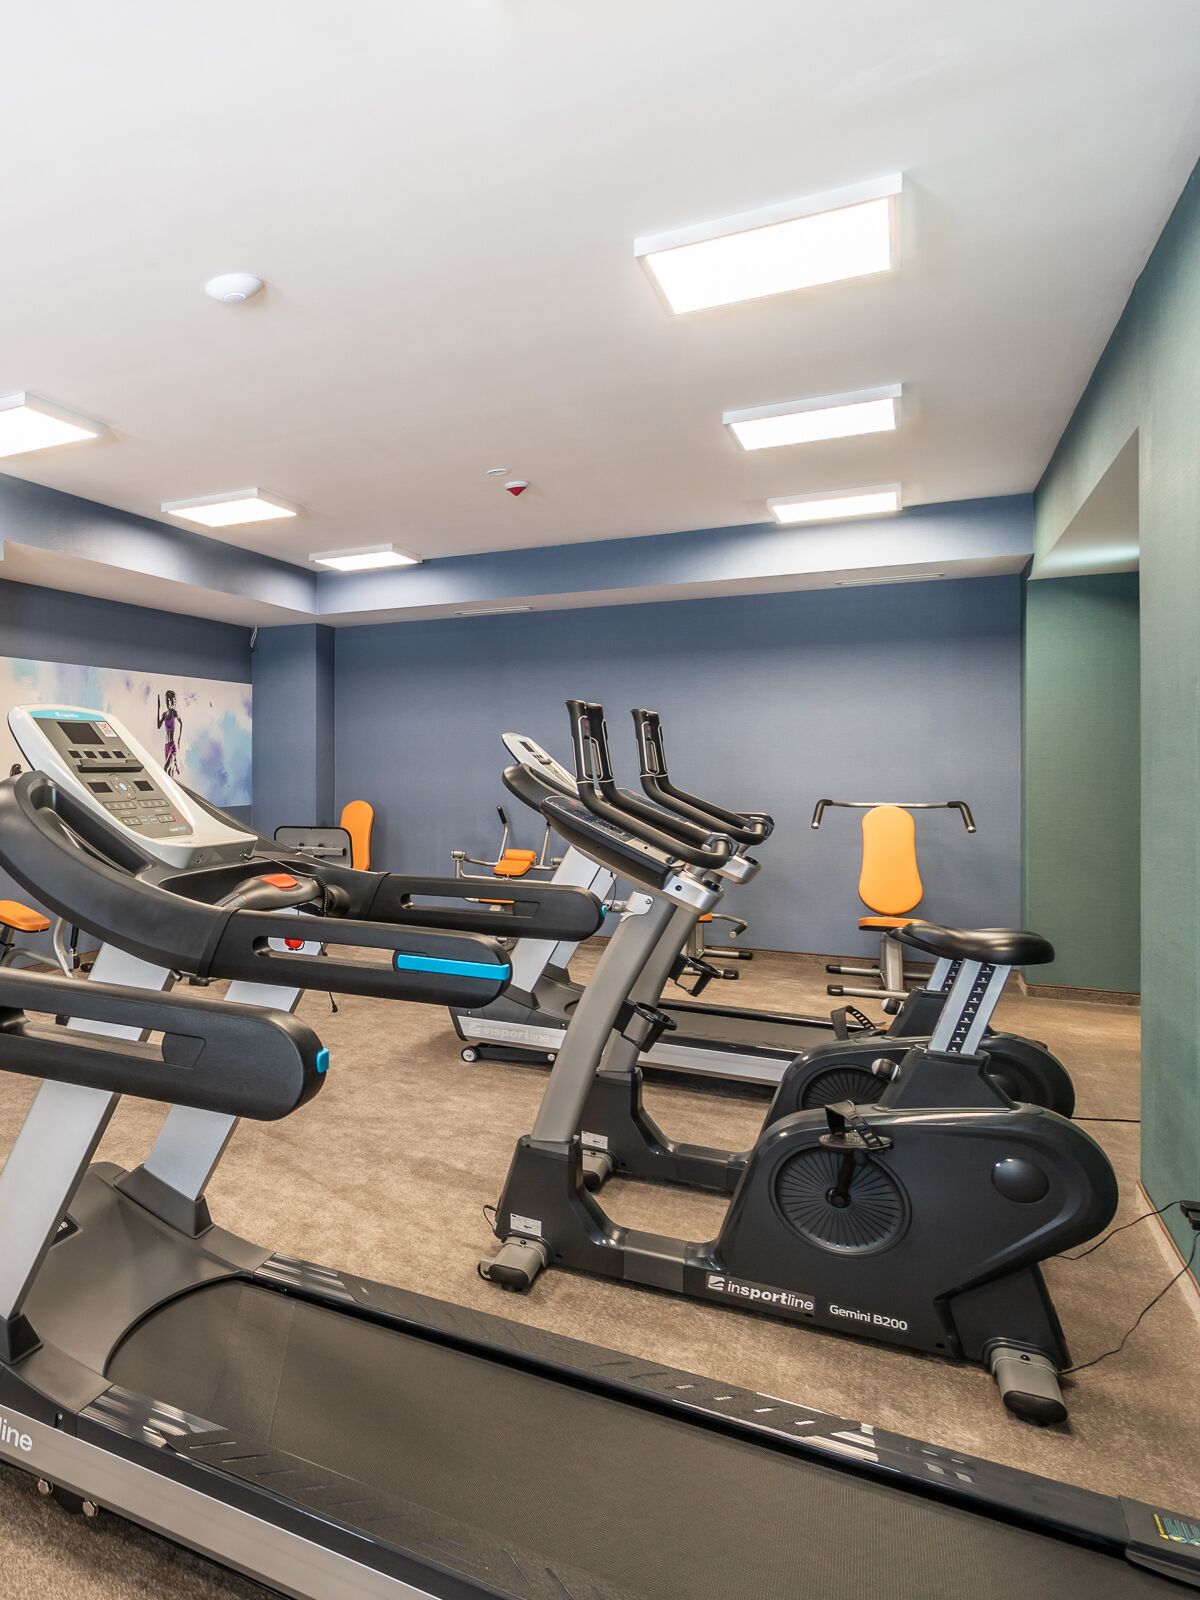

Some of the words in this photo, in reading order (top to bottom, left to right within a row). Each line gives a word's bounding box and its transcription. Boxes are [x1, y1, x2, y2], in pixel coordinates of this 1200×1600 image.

[483, 1024, 550, 1041] insportline
[728, 1280, 814, 1311] insportline
[829, 1304, 871, 1323] Gemini
[873, 1314, 908, 1331] B200
